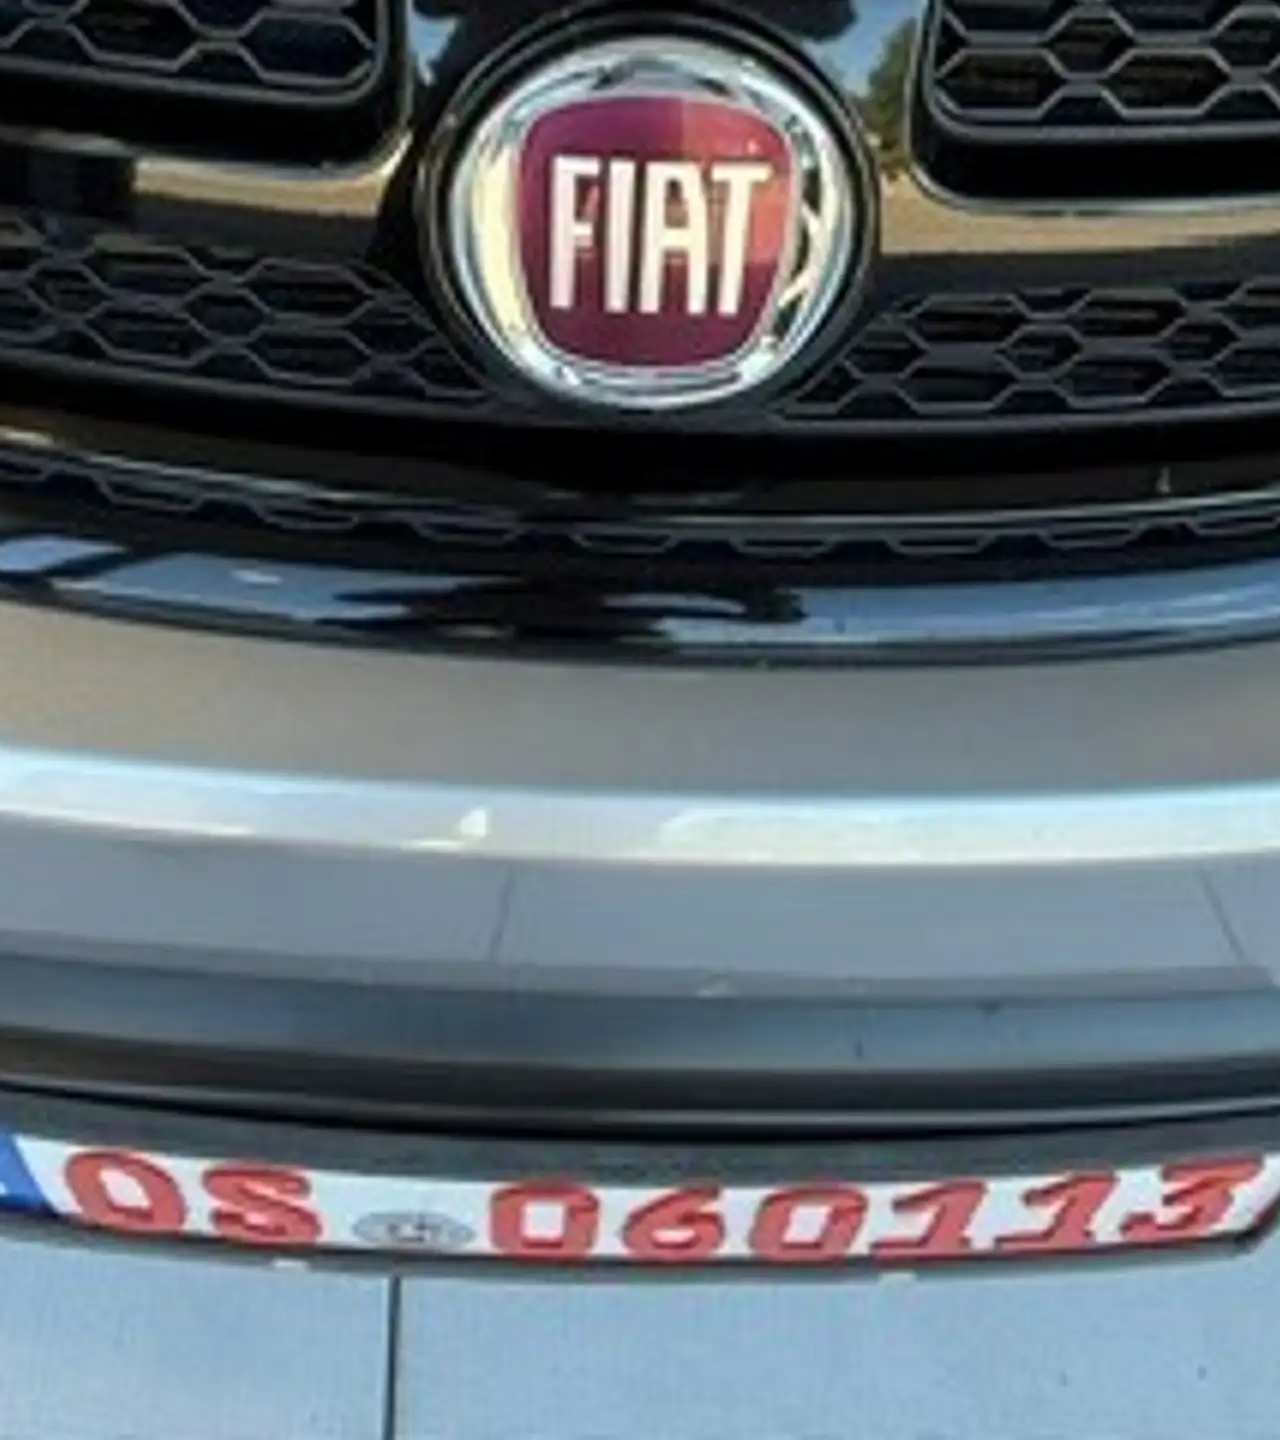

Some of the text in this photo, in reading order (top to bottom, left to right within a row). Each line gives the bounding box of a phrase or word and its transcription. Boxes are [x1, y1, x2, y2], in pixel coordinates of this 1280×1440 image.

[549, 155, 773, 317] FIAT
[64, 1150, 1262, 1262] OS 060113
